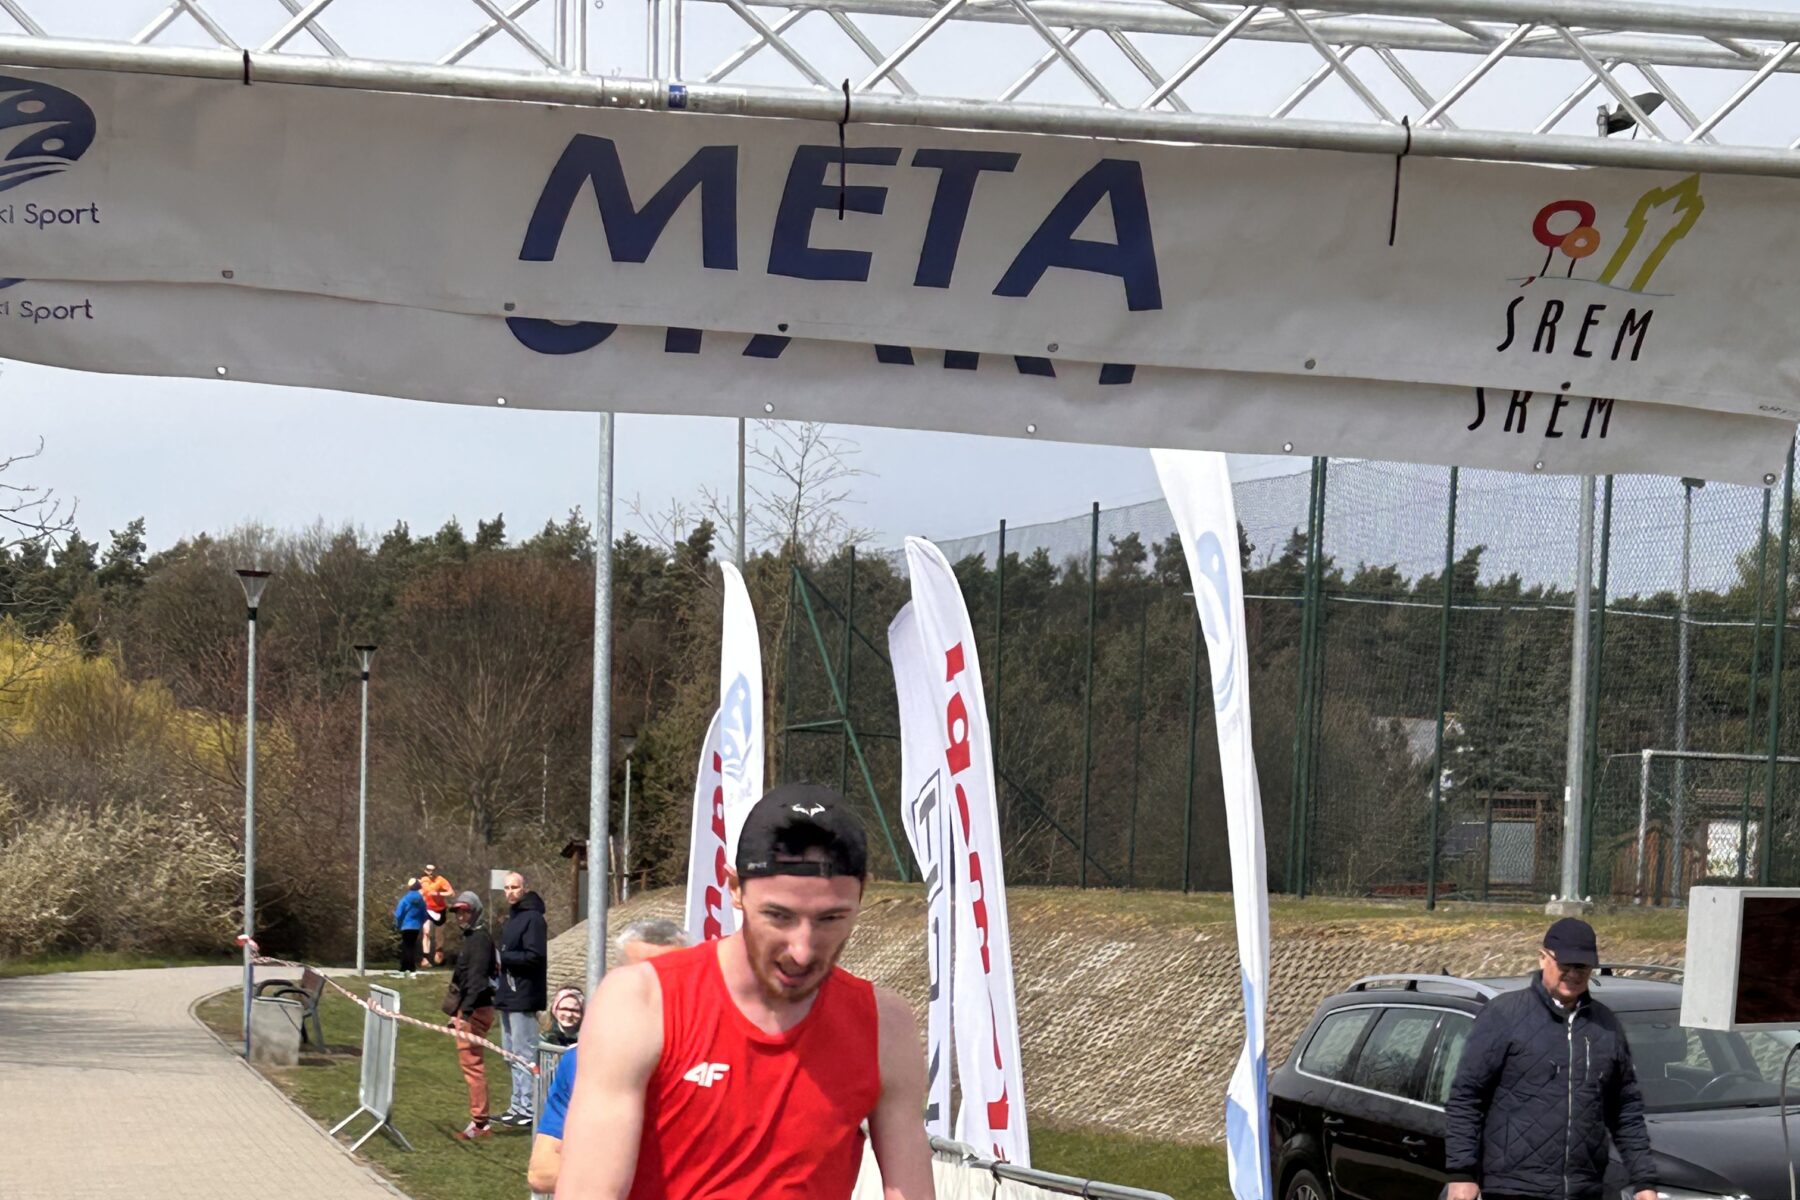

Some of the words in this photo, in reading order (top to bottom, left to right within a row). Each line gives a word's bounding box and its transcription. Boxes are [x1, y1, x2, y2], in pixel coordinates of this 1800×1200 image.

[24, 202, 100, 230] Sport
[518, 132, 1164, 312] META
[20, 299, 94, 324] Sport
[683, 1061, 731, 1088] 4F
